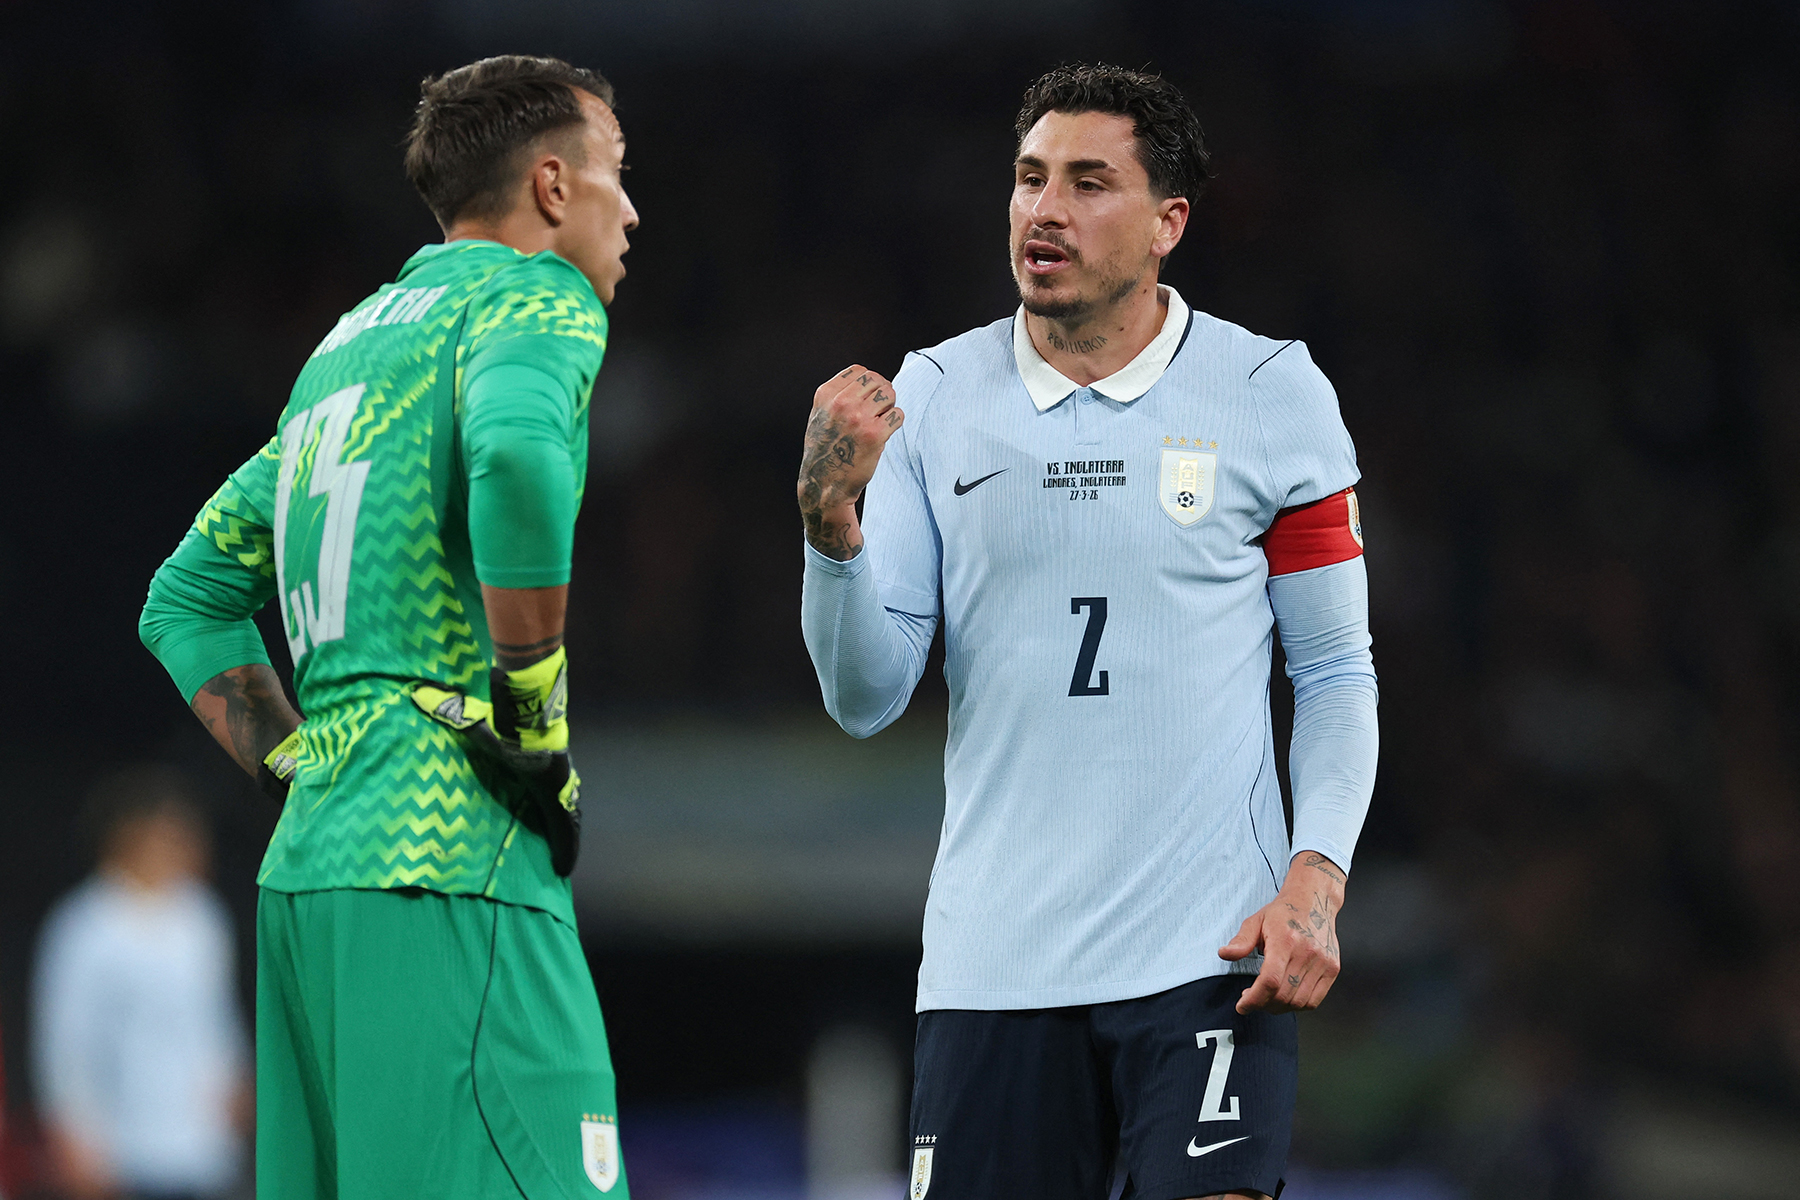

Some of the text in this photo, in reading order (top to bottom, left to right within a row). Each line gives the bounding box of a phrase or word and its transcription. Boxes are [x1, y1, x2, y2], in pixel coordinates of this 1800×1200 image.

[1047, 332, 1108, 354] RESILIENCIA
[1047, 460, 1124, 475] VS. INGLATERRA
[1043, 476, 1126, 489] LONDRES, INGLATERRA
[1068, 597, 1109, 696] 2
[1195, 1029, 1241, 1122] 2
